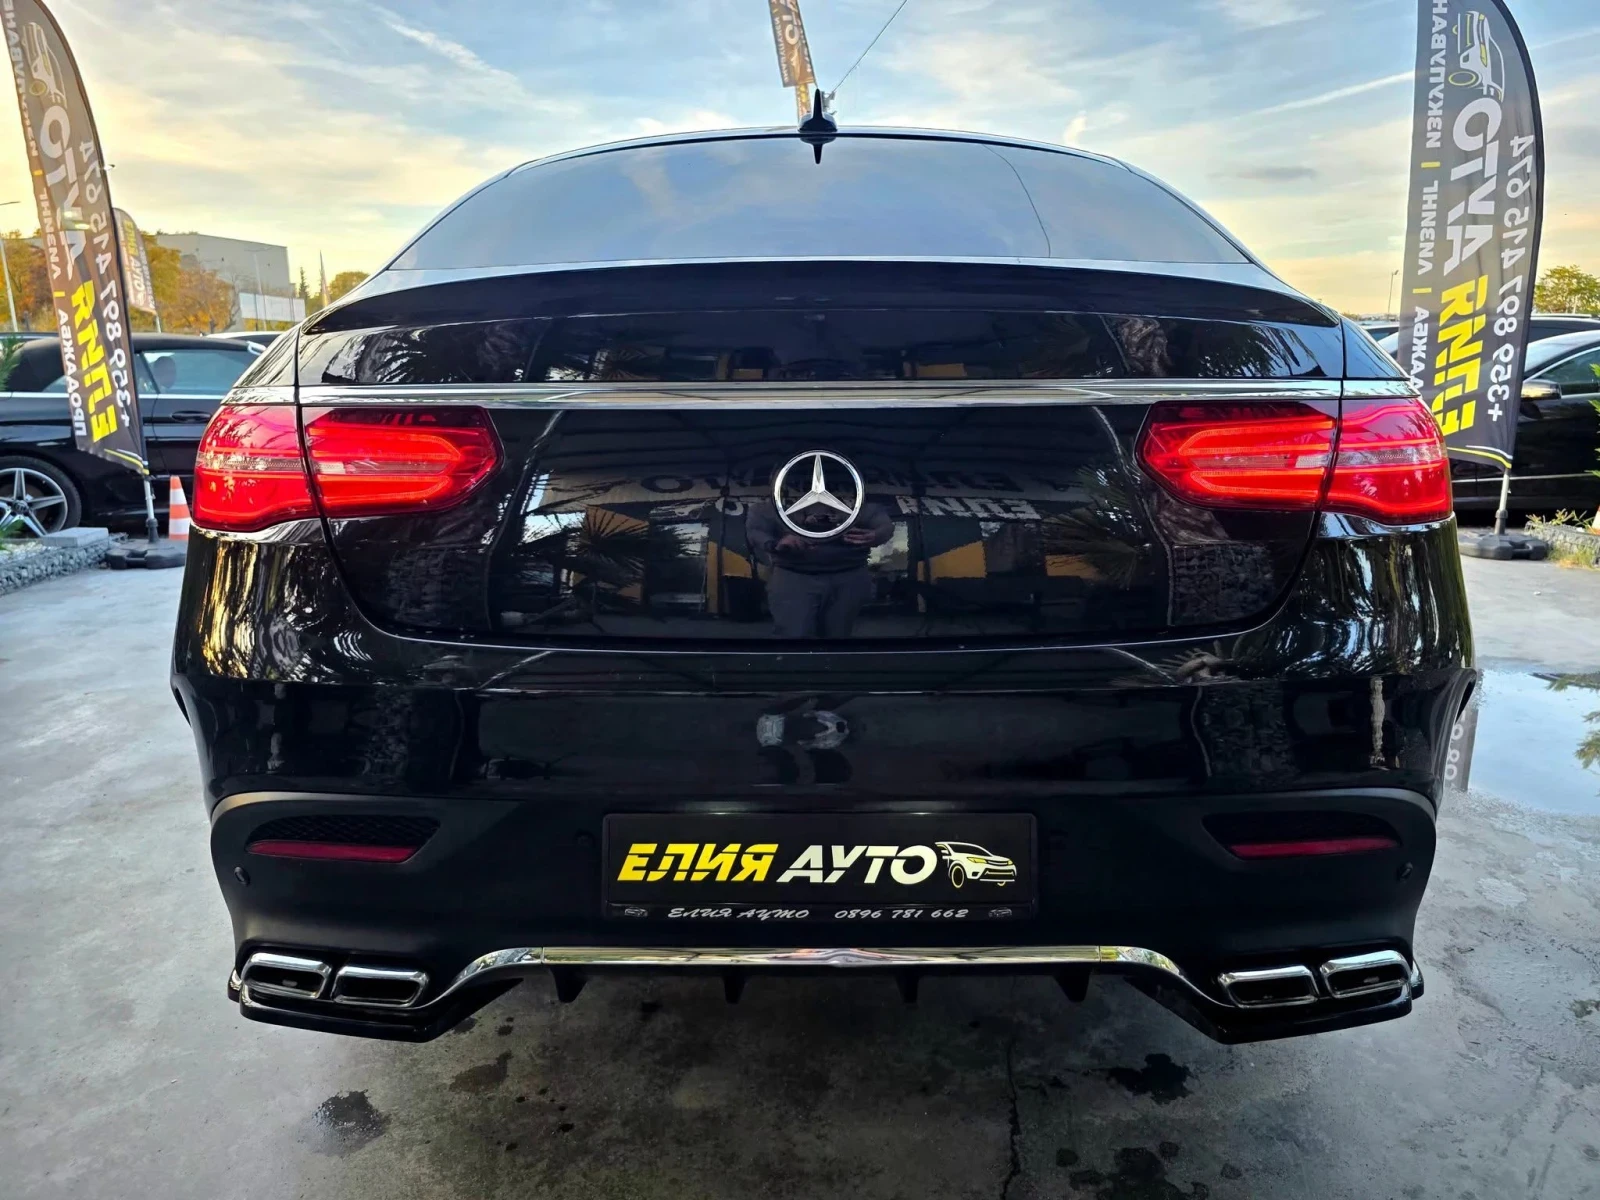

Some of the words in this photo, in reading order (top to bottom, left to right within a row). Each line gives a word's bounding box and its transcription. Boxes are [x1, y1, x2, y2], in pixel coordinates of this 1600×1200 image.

[617, 843, 779, 882] ЕЛИЯ
[776, 844, 938, 885] АУТО
[834, 909, 883, 919] 0896
[891, 909, 923, 919] 781
[931, 909, 969, 919] 662
